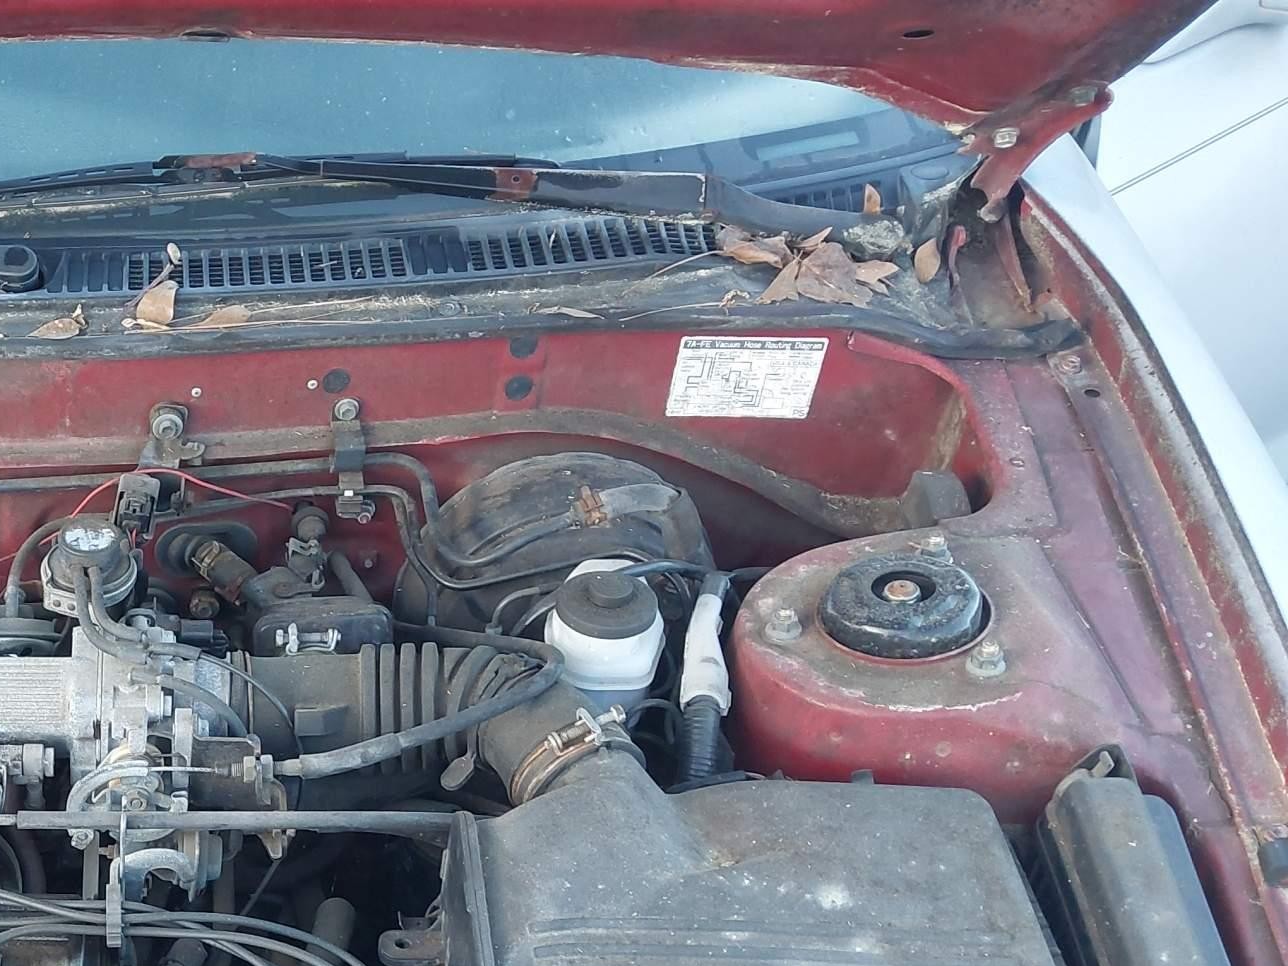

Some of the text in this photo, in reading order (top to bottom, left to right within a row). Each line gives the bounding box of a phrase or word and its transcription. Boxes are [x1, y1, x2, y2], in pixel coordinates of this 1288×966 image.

[686, 340, 824, 351] 7A-FE Vacuum Hose Routing Diagram
